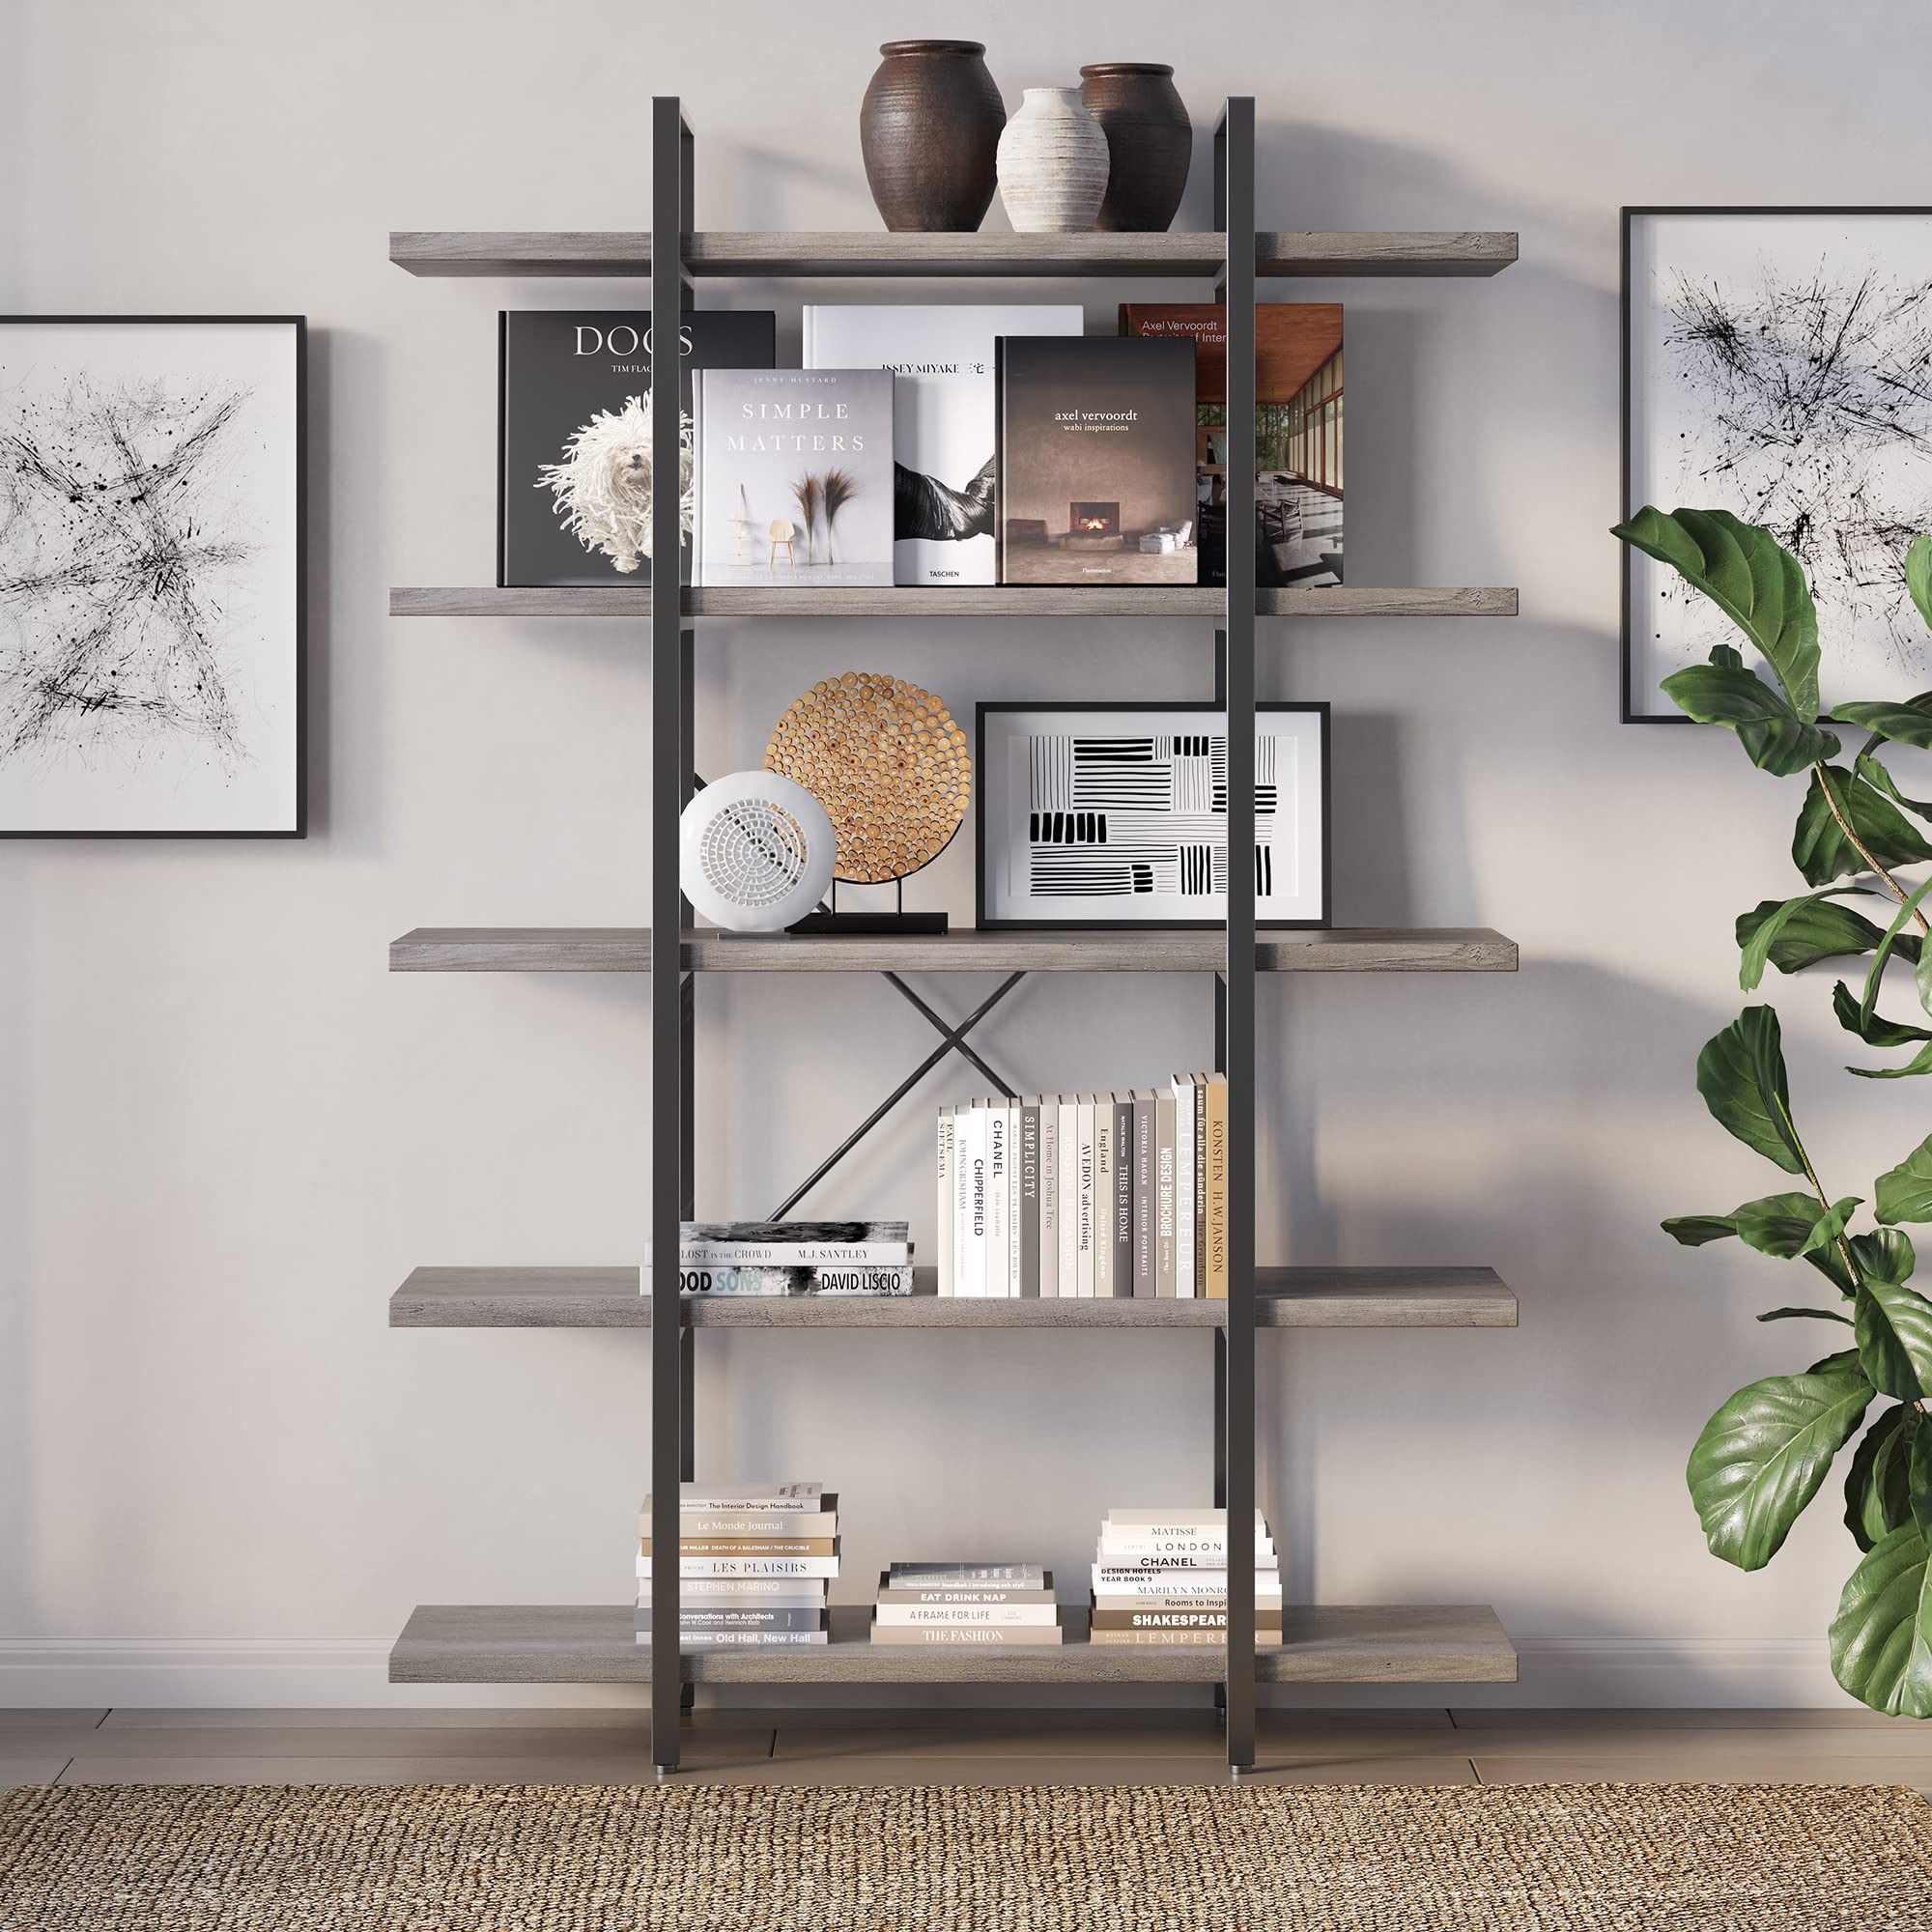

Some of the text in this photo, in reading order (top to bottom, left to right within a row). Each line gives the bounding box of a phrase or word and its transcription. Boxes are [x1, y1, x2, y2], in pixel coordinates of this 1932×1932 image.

[1142, 321, 1217, 330] Axel Vervoordt
[1202, 332, 1226, 342] Inter
[917, 364, 959, 374] MIYAKE
[742, 404, 848, 419] SIMPLE
[1055, 410, 1138, 421] axel vervoordt
[1084, 423, 1129, 433] inspirations
[727, 436, 864, 451] MATTERS
[1046, 1122, 1054, 1134] At
[1197, 1118, 1206, 1132] für
[993, 1121, 1003, 1179] CHANEL
[1097, 1128, 1109, 1174] England
[1197, 1135, 1206, 1153] alla
[1212, 1121, 1223, 1181] KONSTEN
[1024, 1117, 1035, 1199] SIMPLICITY
[1064, 1136, 1073, 1190] KONSTEN
[1160, 1148, 1172, 1182] DESIGN
[1197, 1156, 1206, 1170] die
[1046, 1165, 1054, 1175] in
[974, 1159, 983, 1236] CHIPPERFIELD
[1044, 1177, 1054, 1208] Joshua
[1079, 1143, 1091, 1251] AVEDON advertising
[1197, 1173, 1206, 1214] sünderin
[1119, 1165, 1128, 1242] THIS IS HOME
[1179, 1132, 1192, 1272] LEMPEREUR
[1160, 1184, 1172, 1236] BROCHURE
[1097, 1208, 1108, 1279] United Kingdom
[681, 1250, 708, 1260] LOST
[734, 1250, 772, 1260] CROWD
[819, 1250, 869, 1260] SANTLEY
[716, 1271, 762, 1292] SONS
[822, 1273, 900, 1291] DAVID LISCIO
[697, 1521, 783, 1530] Le Monde Journal
[1156, 1543, 1222, 1551] LONDON
[713, 1563, 737, 1573] LES
[744, 1563, 808, 1573] PLAISIRS
[1140, 1557, 1197, 1567] CHANEL
[687, 1581, 780, 1592] STEPHEN MARINO
[1207, 1599, 1227, 1608] Inspi
[910, 1610, 917, 1620] A
[919, 1610, 950, 1620] FRAME
[952, 1610, 968, 1620] FOR
[972, 1610, 990, 1620] LIFE
[1132, 1614, 1227, 1626] SHAKESPEAR
[716, 1634, 810, 1644] Old Hall, New Hall
[923, 1630, 1004, 1641] THE FASHION
[1136, 1633, 1261, 1643] LEMPERER
